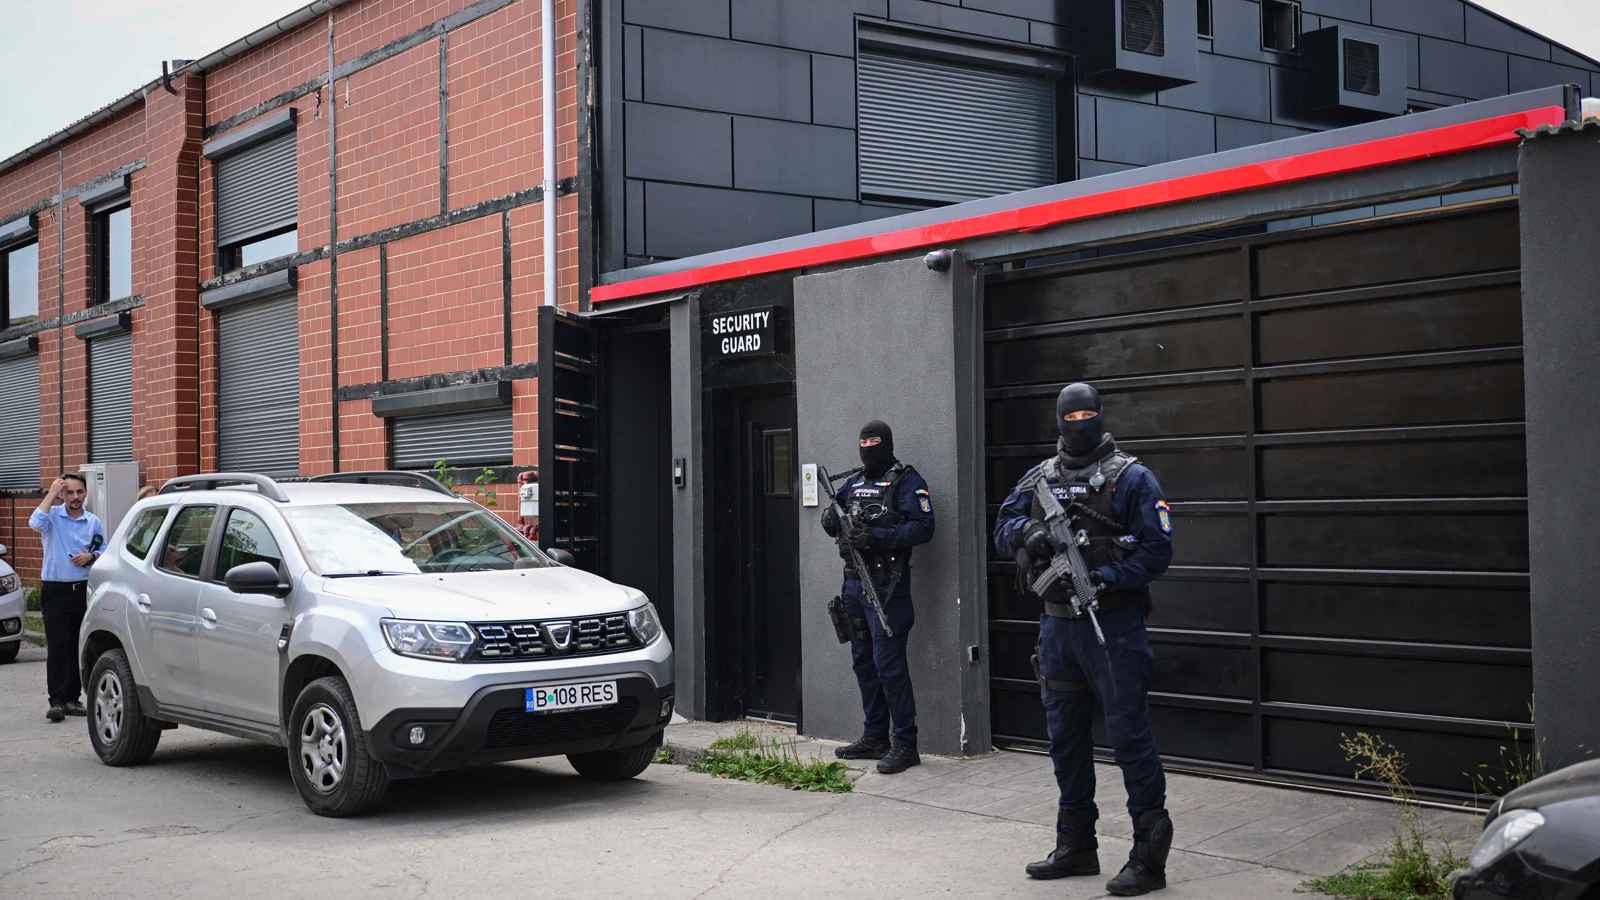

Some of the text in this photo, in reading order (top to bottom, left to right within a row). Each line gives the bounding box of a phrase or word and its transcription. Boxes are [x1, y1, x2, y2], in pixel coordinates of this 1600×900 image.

[712, 311, 770, 334] SECURITY
[721, 333, 761, 354] GUARD
[536, 684, 614, 707] B 108 RES
